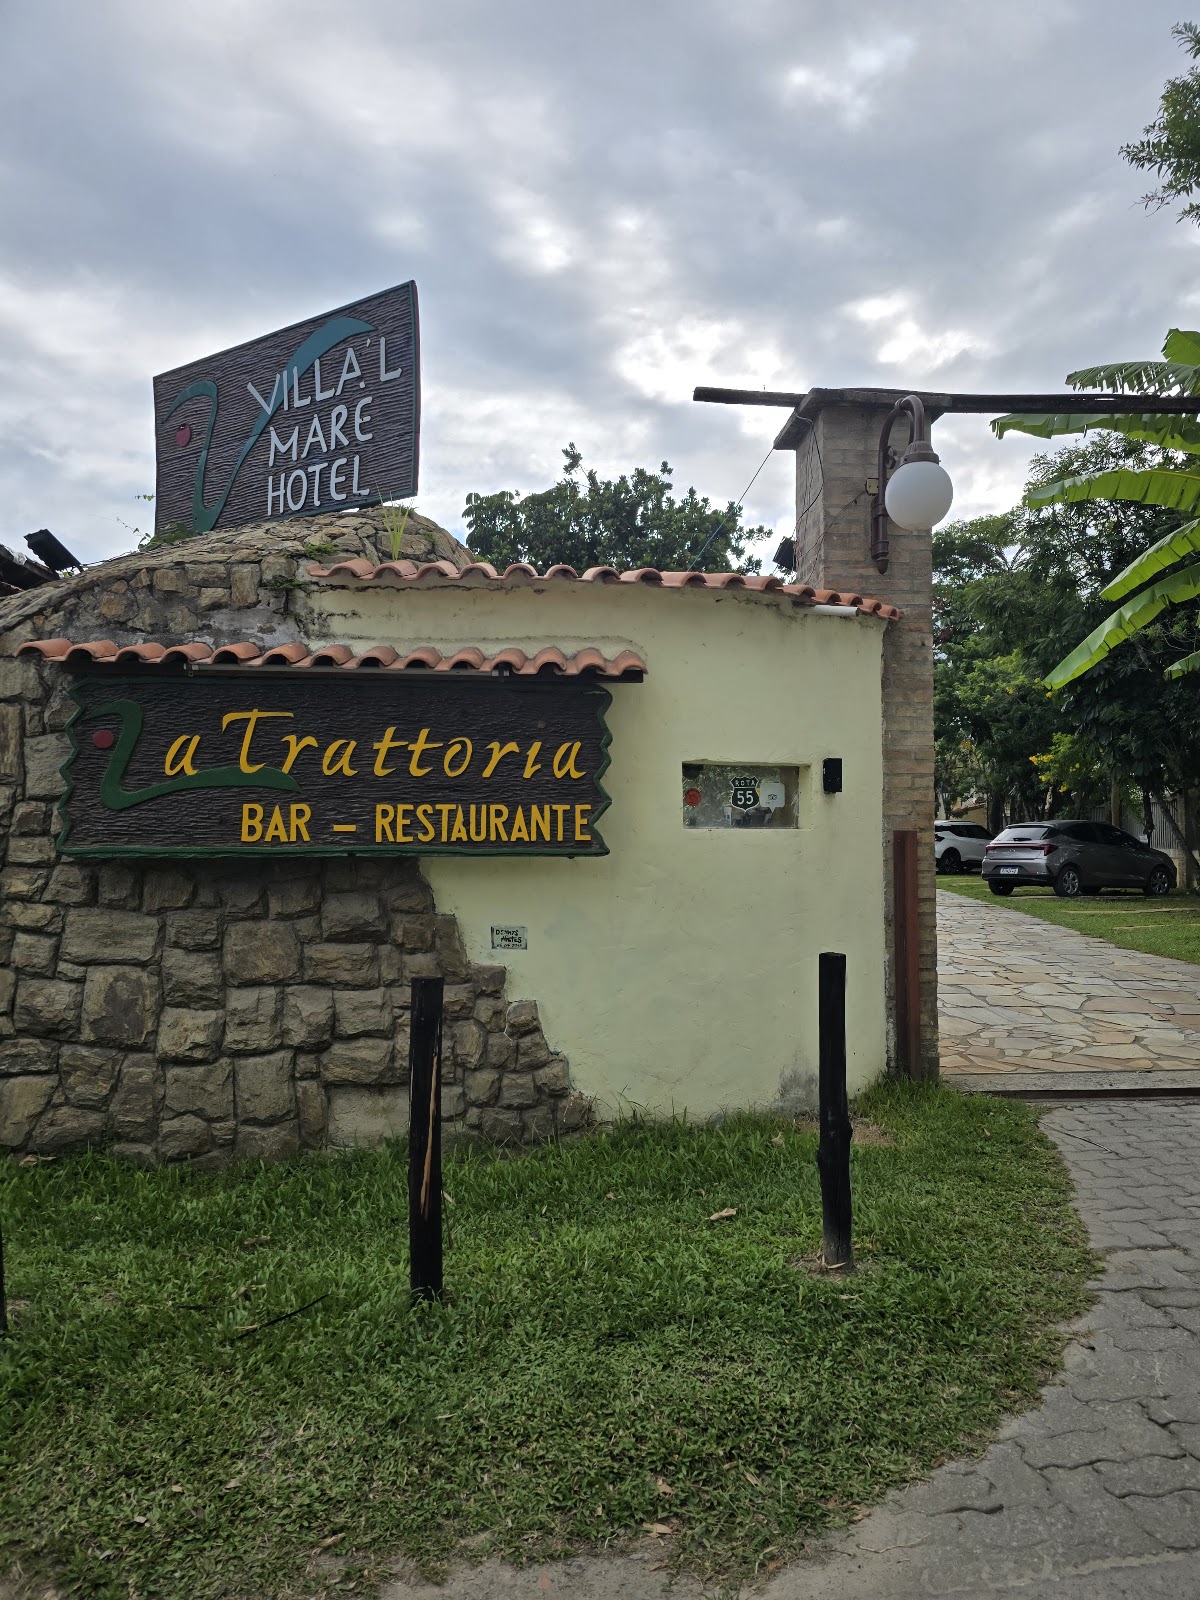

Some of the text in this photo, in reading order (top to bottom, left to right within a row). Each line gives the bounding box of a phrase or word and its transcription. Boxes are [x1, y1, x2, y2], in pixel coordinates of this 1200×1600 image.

[268, 396, 373, 467] MARE
[267, 454, 370, 516] HOTEL
[222, 708, 587, 778] Trattoria
[241, 803, 312, 842] BAR
[375, 804, 593, 842] RESTAURANTE
[737, 791, 753, 804] 55
